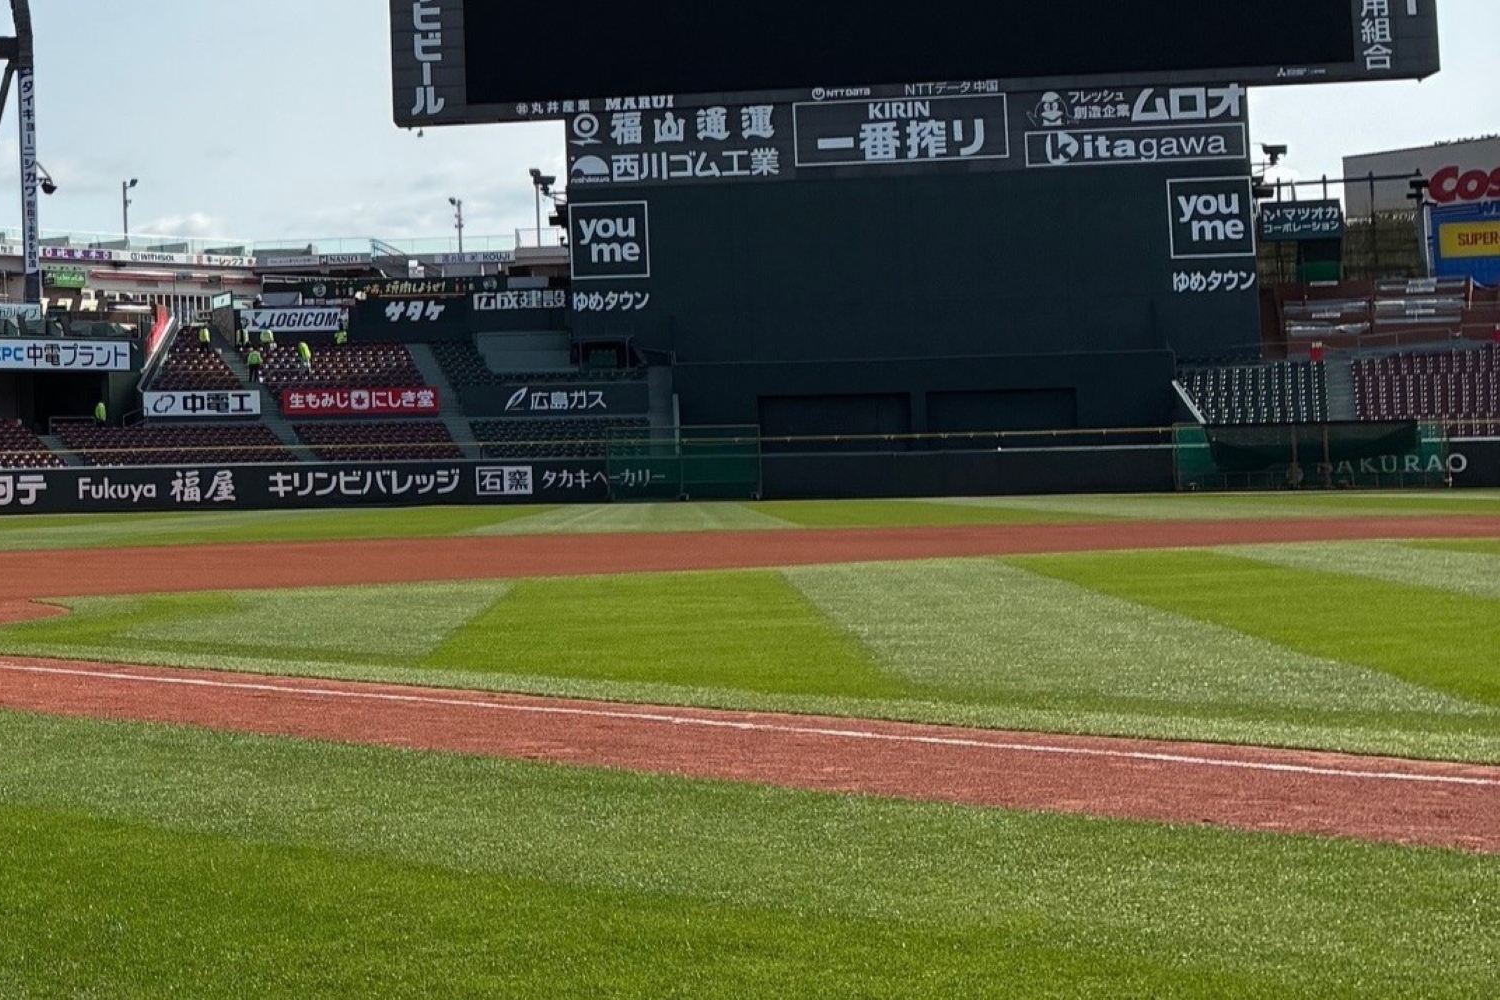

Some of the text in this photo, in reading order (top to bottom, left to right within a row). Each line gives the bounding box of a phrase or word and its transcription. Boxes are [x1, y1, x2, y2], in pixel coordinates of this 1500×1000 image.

[411, 0, 444, 116] ヒビール
[604, 95, 674, 111] MARUI
[1068, 90, 1124, 104] フレッシュ
[1131, 83, 1247, 122] ムロオ
[868, 101, 930, 119] KIRIN
[1073, 104, 1130, 119] 創造企業
[610, 105, 775, 145] 福山通運
[817, 118, 985, 160] 一番搾り
[611, 148, 780, 182] 西川ゴム工業
[1178, 193, 1239, 223] you
[579, 217, 635, 245] you
[1192, 217, 1245, 242] me
[1263, 221, 1340, 234] コーポレーション
[591, 241, 641, 263] me
[1173, 270, 1256, 293] ゆめタウン
[473, 289, 567, 310] 広成建設
[573, 290, 650, 312] ゆめタウン
[385, 301, 445, 322] サタケ
[27, 343, 128, 368] 中電プラント
[182, 392, 254, 414] 中電工
[289, 390, 435, 409] 生もみじ にしき堂
[530, 390, 607, 411] 広島ガス
[78, 470, 237, 502] Fukuya 福屋
[269, 469, 460, 498] キリンビバレッジ
[480, 469, 529, 491] 石窯
